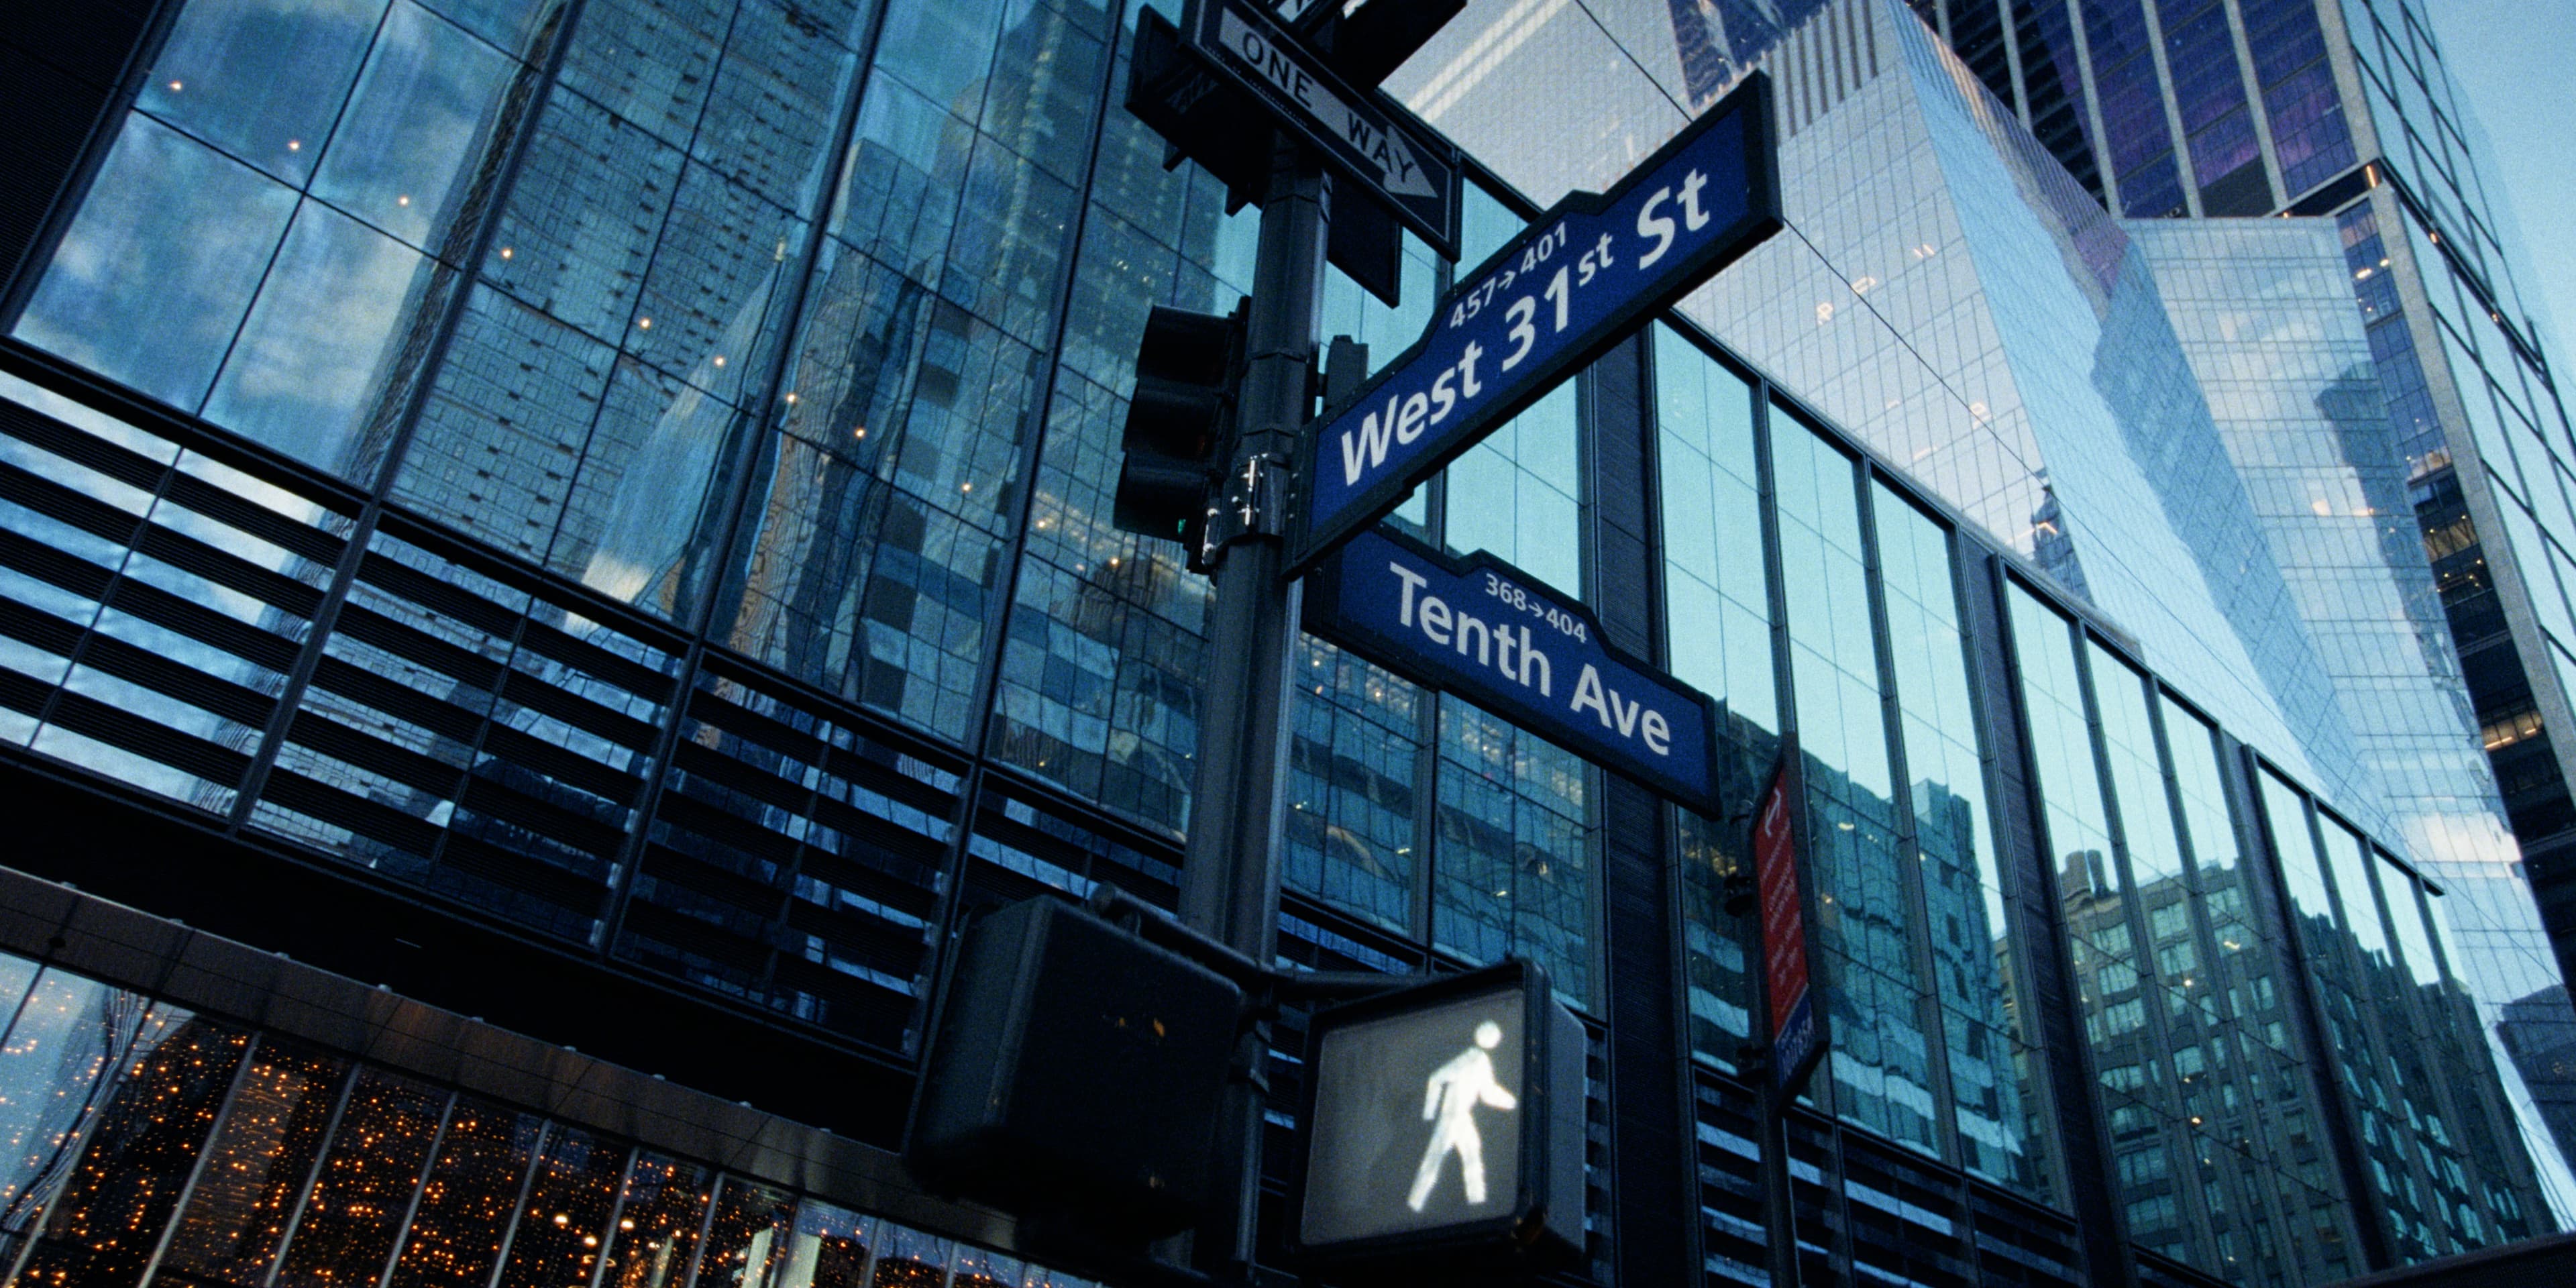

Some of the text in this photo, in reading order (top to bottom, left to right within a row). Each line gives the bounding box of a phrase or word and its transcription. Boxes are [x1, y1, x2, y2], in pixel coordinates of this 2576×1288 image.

[1242, 32, 1313, 109] ONE
[1348, 111, 1415, 183] WAY
[1341, 168, 1710, 486] West 31st St
[1450, 222, 1566, 329] 457 401
[1390, 561, 1670, 755] Tenth Ave
[1485, 573, 1587, 644] 368 404
